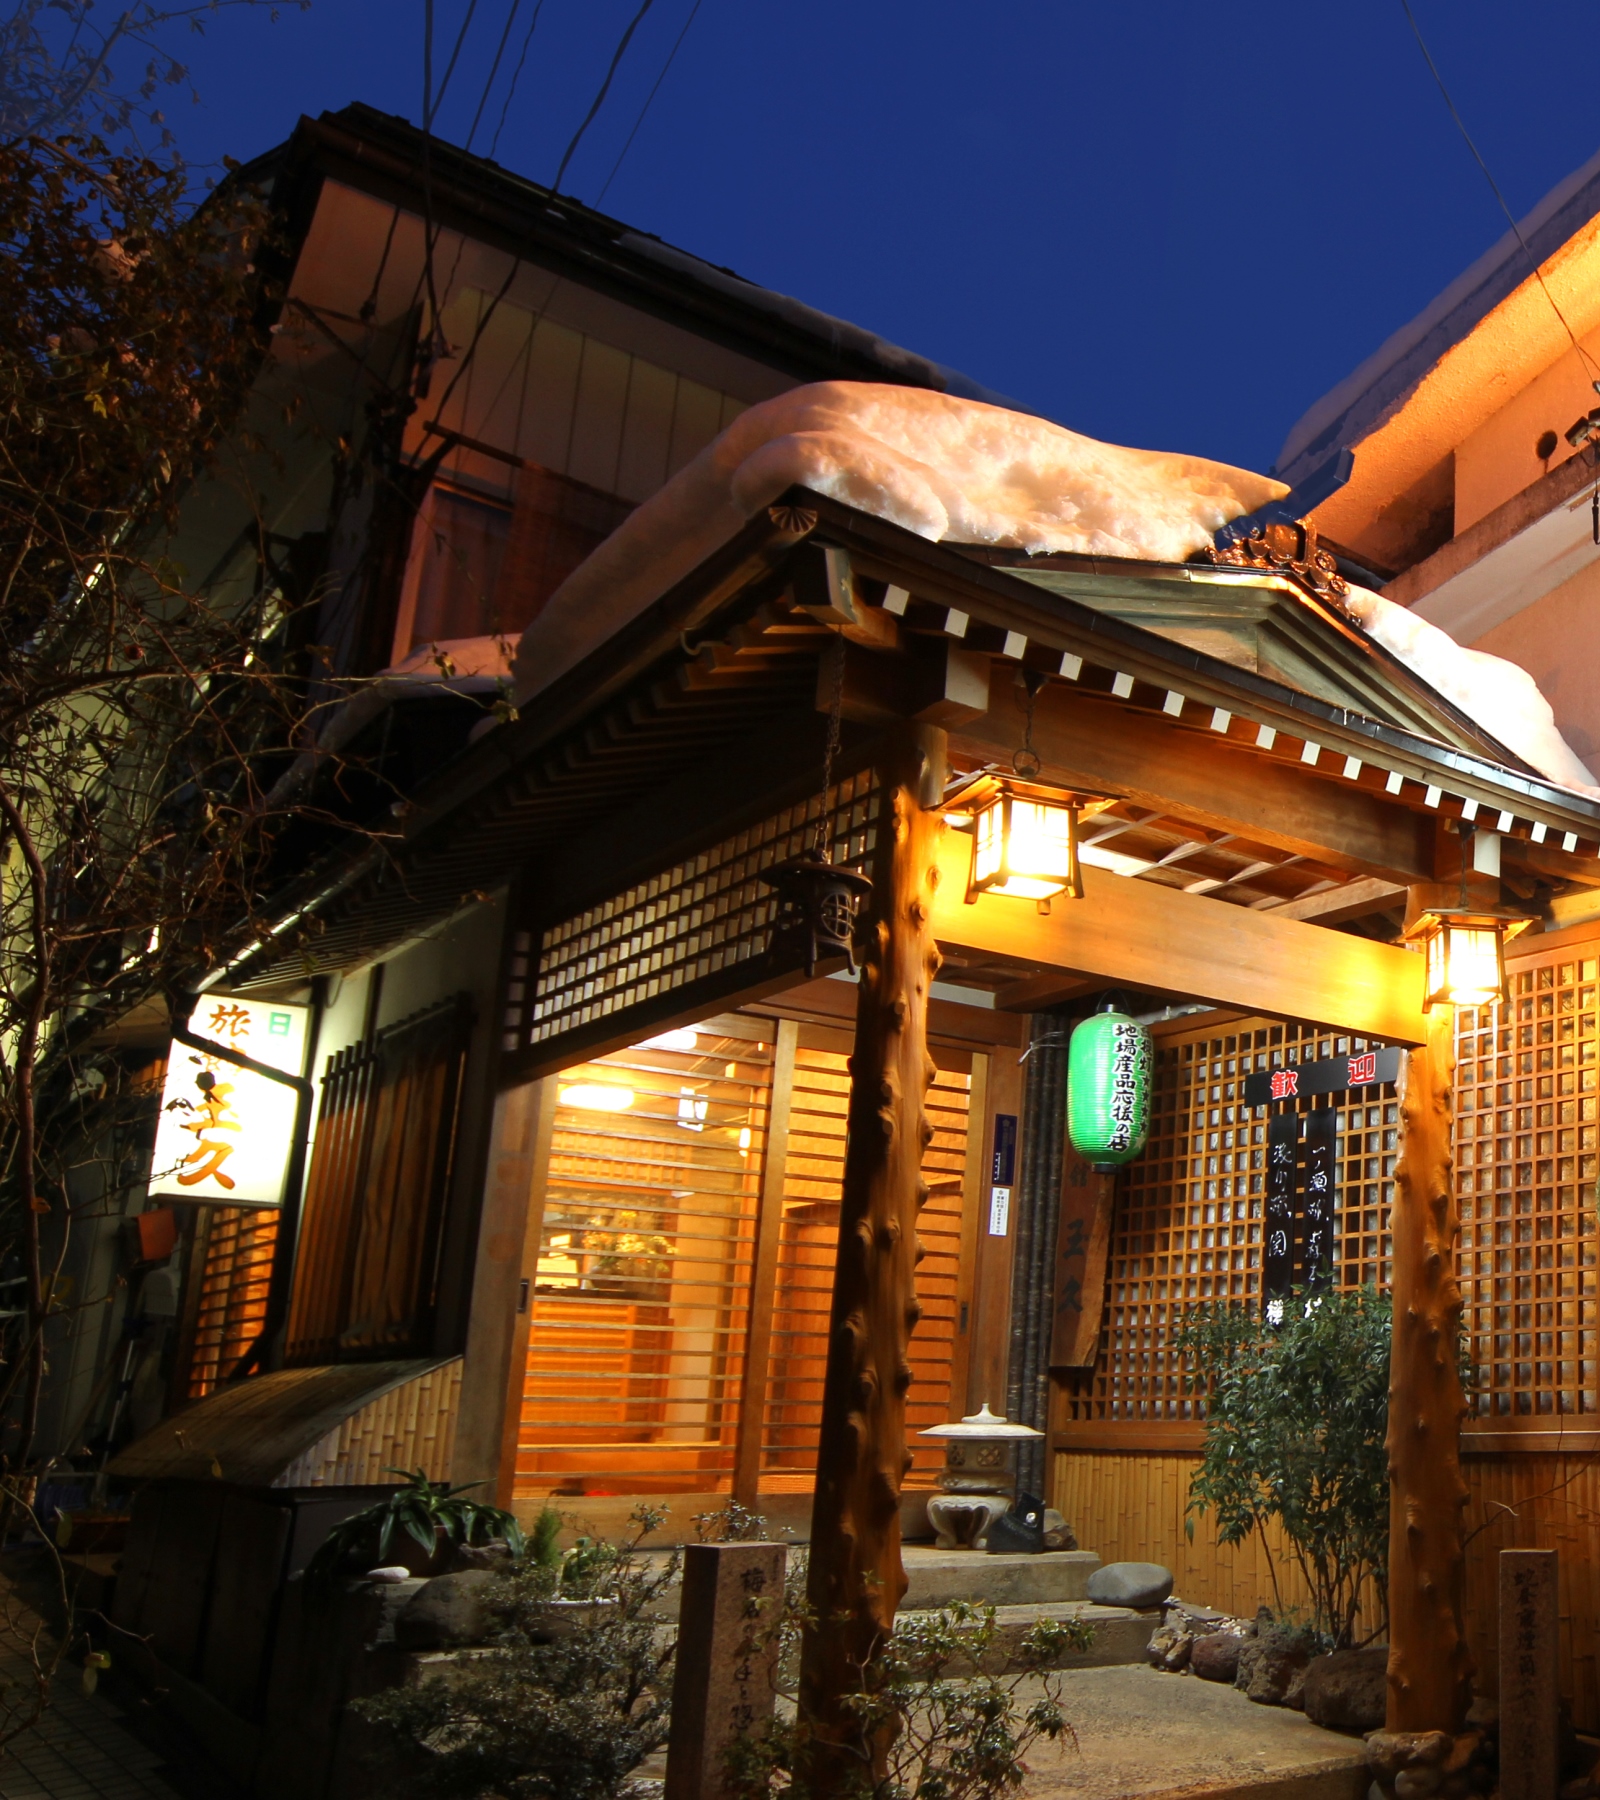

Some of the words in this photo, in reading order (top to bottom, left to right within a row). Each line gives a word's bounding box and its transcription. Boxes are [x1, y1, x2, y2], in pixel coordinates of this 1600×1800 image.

[1106, 1023, 1139, 1153] 地場産品応援の店
[1270, 1051, 1376, 1099] 歓迎
